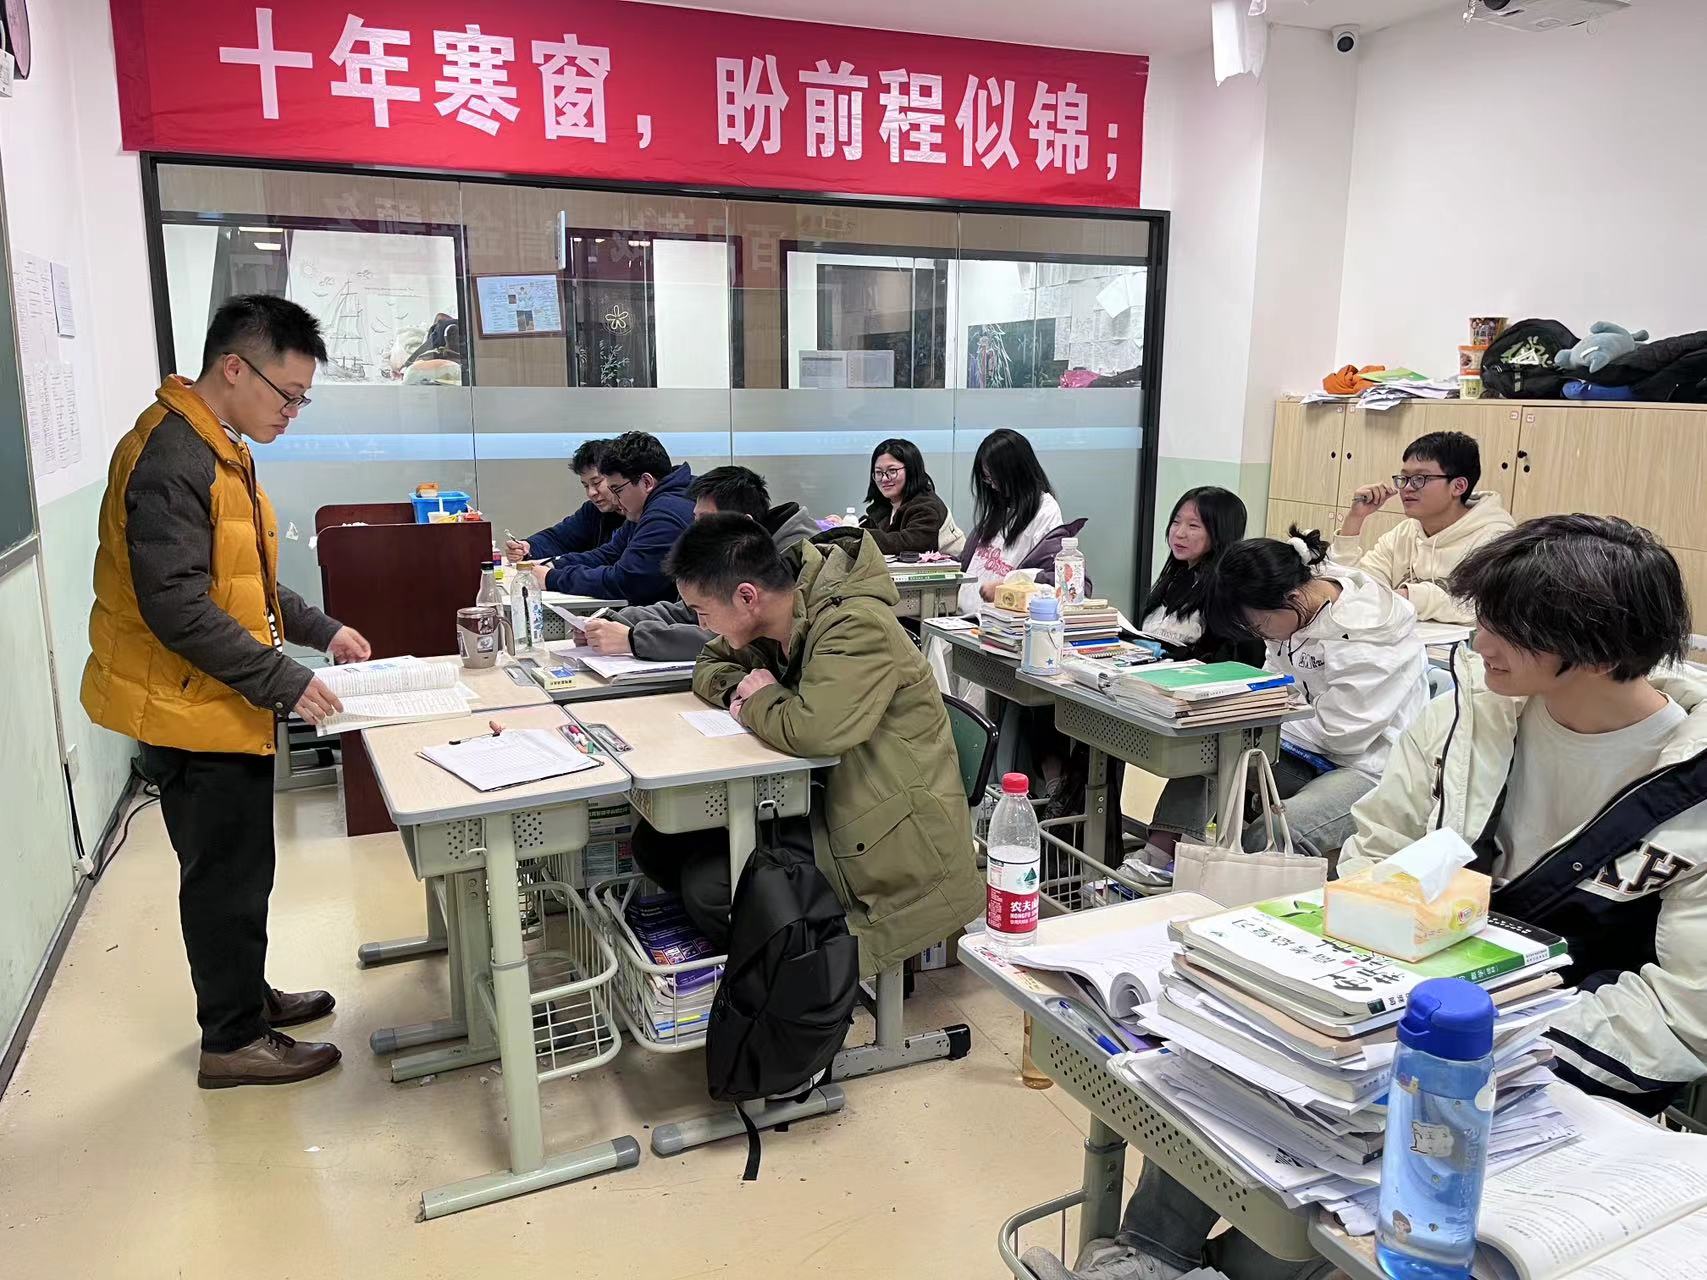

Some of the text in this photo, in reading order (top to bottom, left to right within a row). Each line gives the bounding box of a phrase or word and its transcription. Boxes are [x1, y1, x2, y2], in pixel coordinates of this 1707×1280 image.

[218, 7, 1120, 181] 十年寒窗，盼前程似锦；
